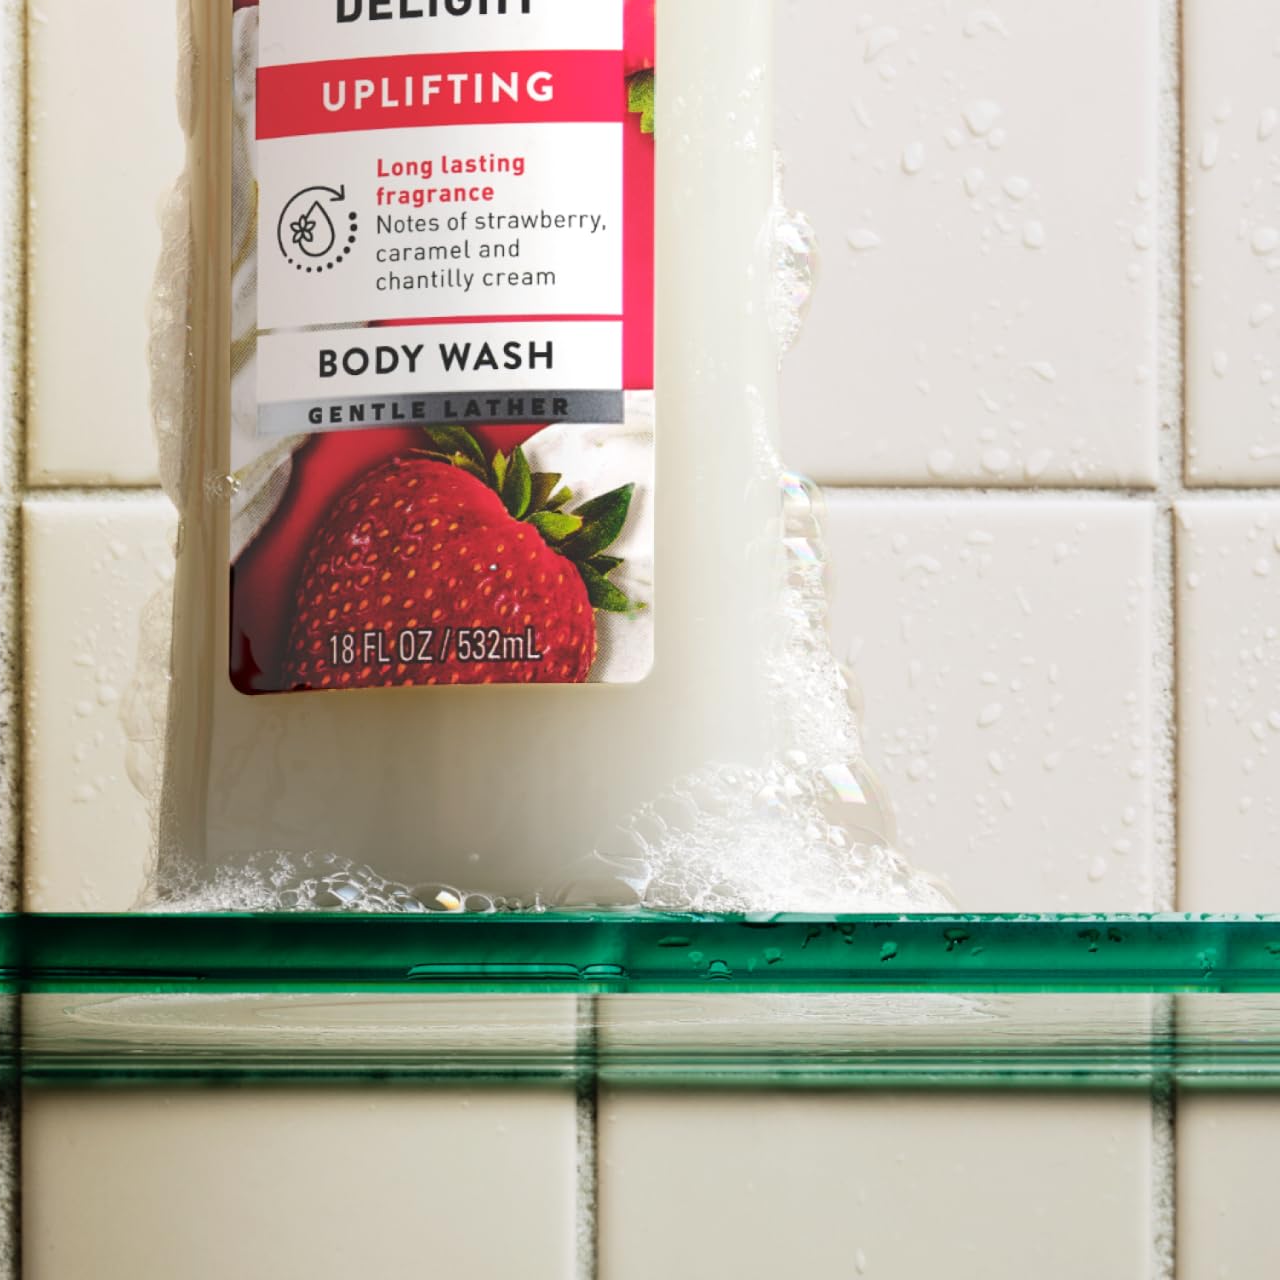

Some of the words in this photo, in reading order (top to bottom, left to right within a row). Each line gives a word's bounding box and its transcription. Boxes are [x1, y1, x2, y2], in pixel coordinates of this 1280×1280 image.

[322, 71, 555, 112] UPLIFTING
[377, 158, 433, 180] Long
[440, 154, 525, 177] lasting
[376, 183, 495, 206] fragrance
[376, 214, 440, 234] Notes
[447, 211, 468, 230] of
[474, 210, 607, 233] strawberry,
[376, 241, 471, 263] caramel
[479, 239, 520, 259] and
[376, 269, 474, 292] chantilly
[481, 267, 556, 288] cream
[319, 344, 424, 378] BODY
[439, 341, 554, 371] WASH
[308, 400, 425, 425] GENTLE
[444, 398, 570, 419] LATHER
